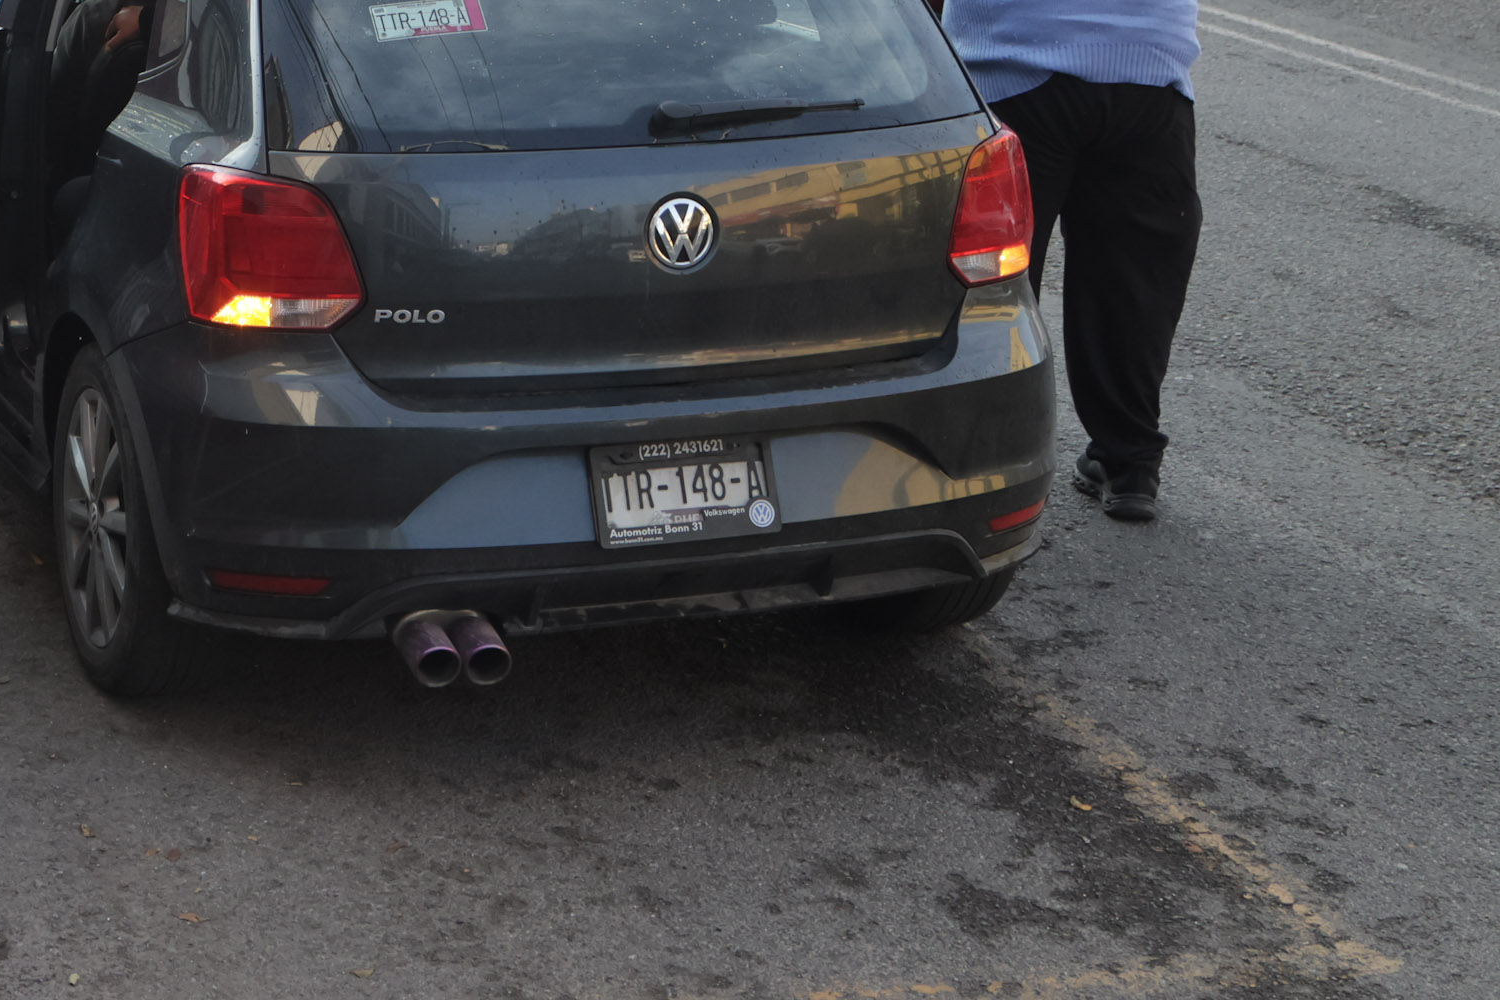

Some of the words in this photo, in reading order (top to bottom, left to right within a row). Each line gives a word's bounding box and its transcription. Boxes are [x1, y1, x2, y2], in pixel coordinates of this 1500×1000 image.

[376, 7, 467, 32] TTR-148-A
[374, 309, 446, 324] POLO
[639, 443, 671, 460] (222)
[674, 439, 724, 455] 2431621
[703, 507, 745, 518] Volkswagen
[610, 524, 662, 539] Automotriz
[665, 524, 689, 534] Bonn
[692, 522, 703, 531] 31
